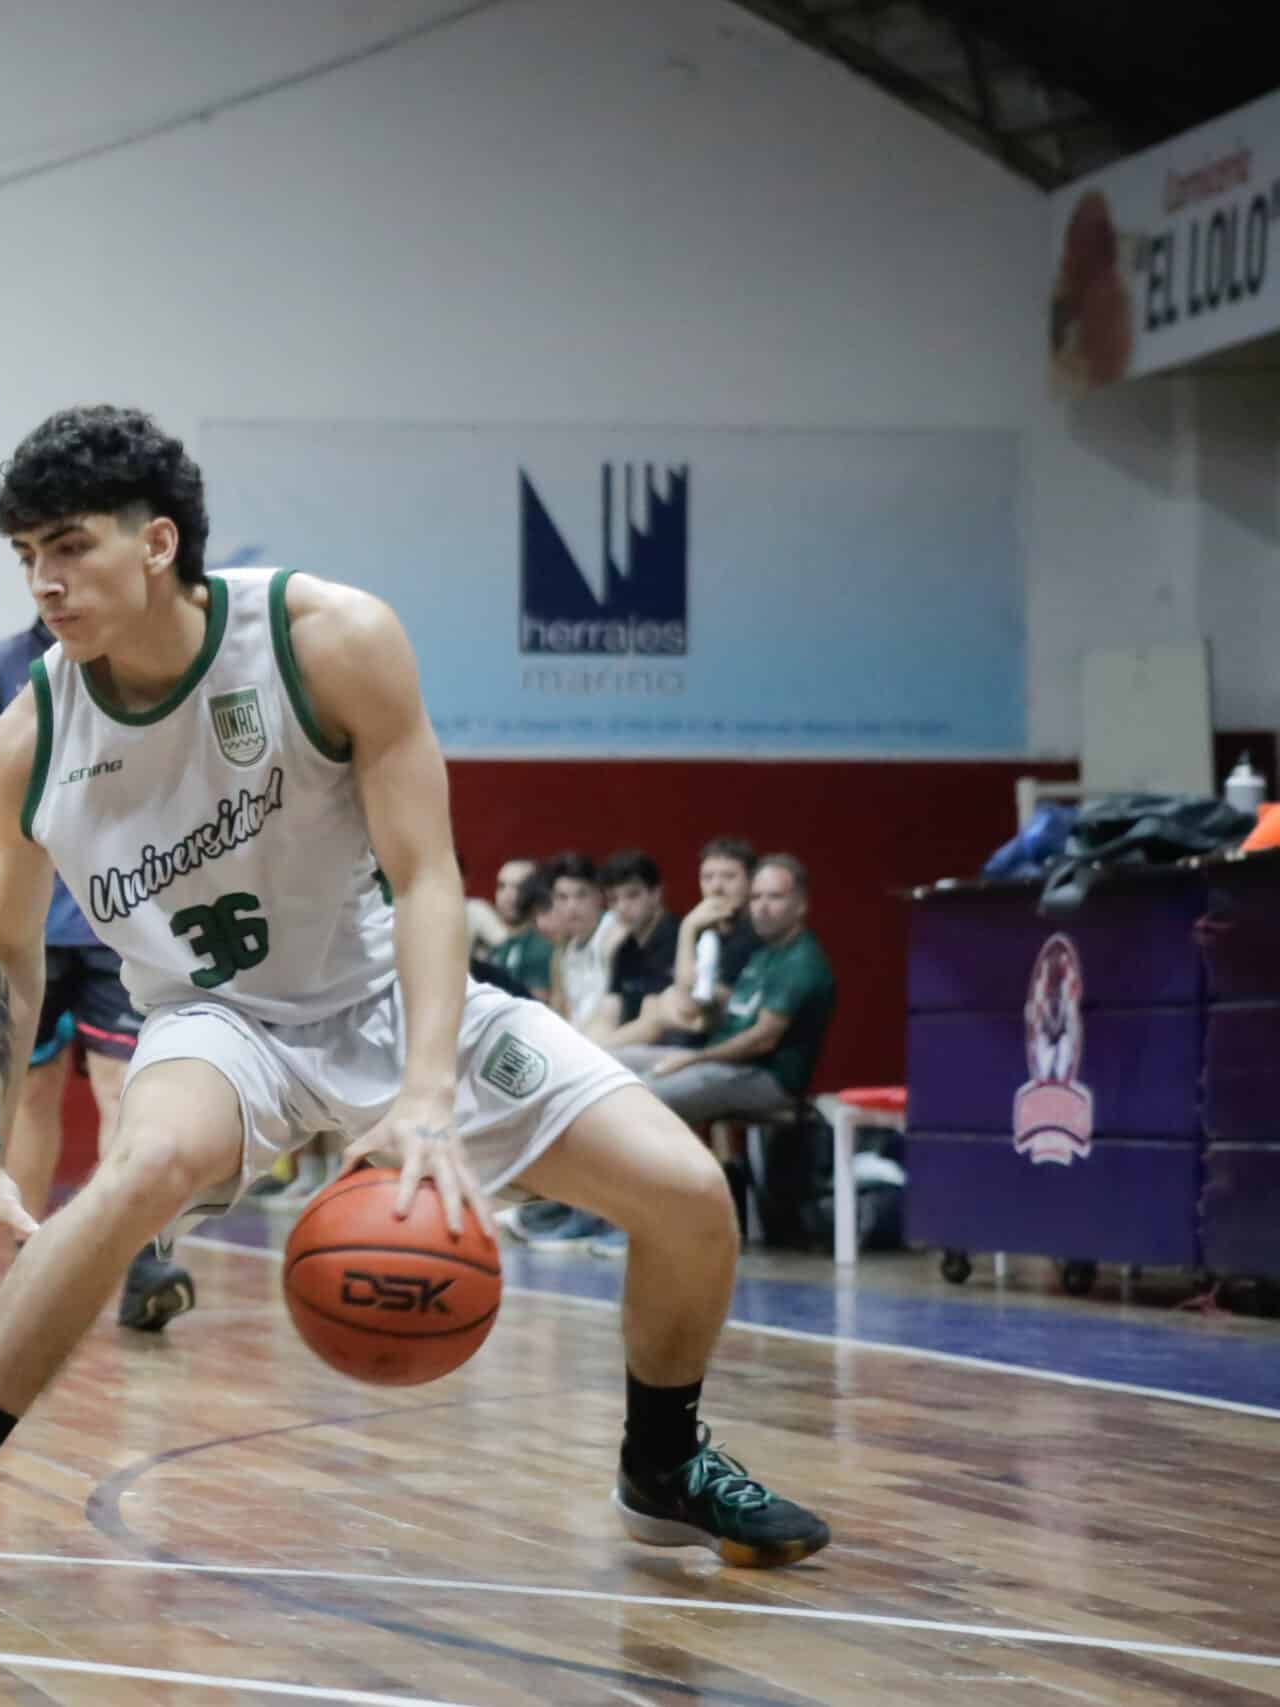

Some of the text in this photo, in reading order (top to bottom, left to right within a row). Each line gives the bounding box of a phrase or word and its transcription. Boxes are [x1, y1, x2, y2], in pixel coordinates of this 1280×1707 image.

[522, 611, 687, 655] herrajes
[90, 767, 283, 923] Universidad
[170, 892, 269, 989] 36
